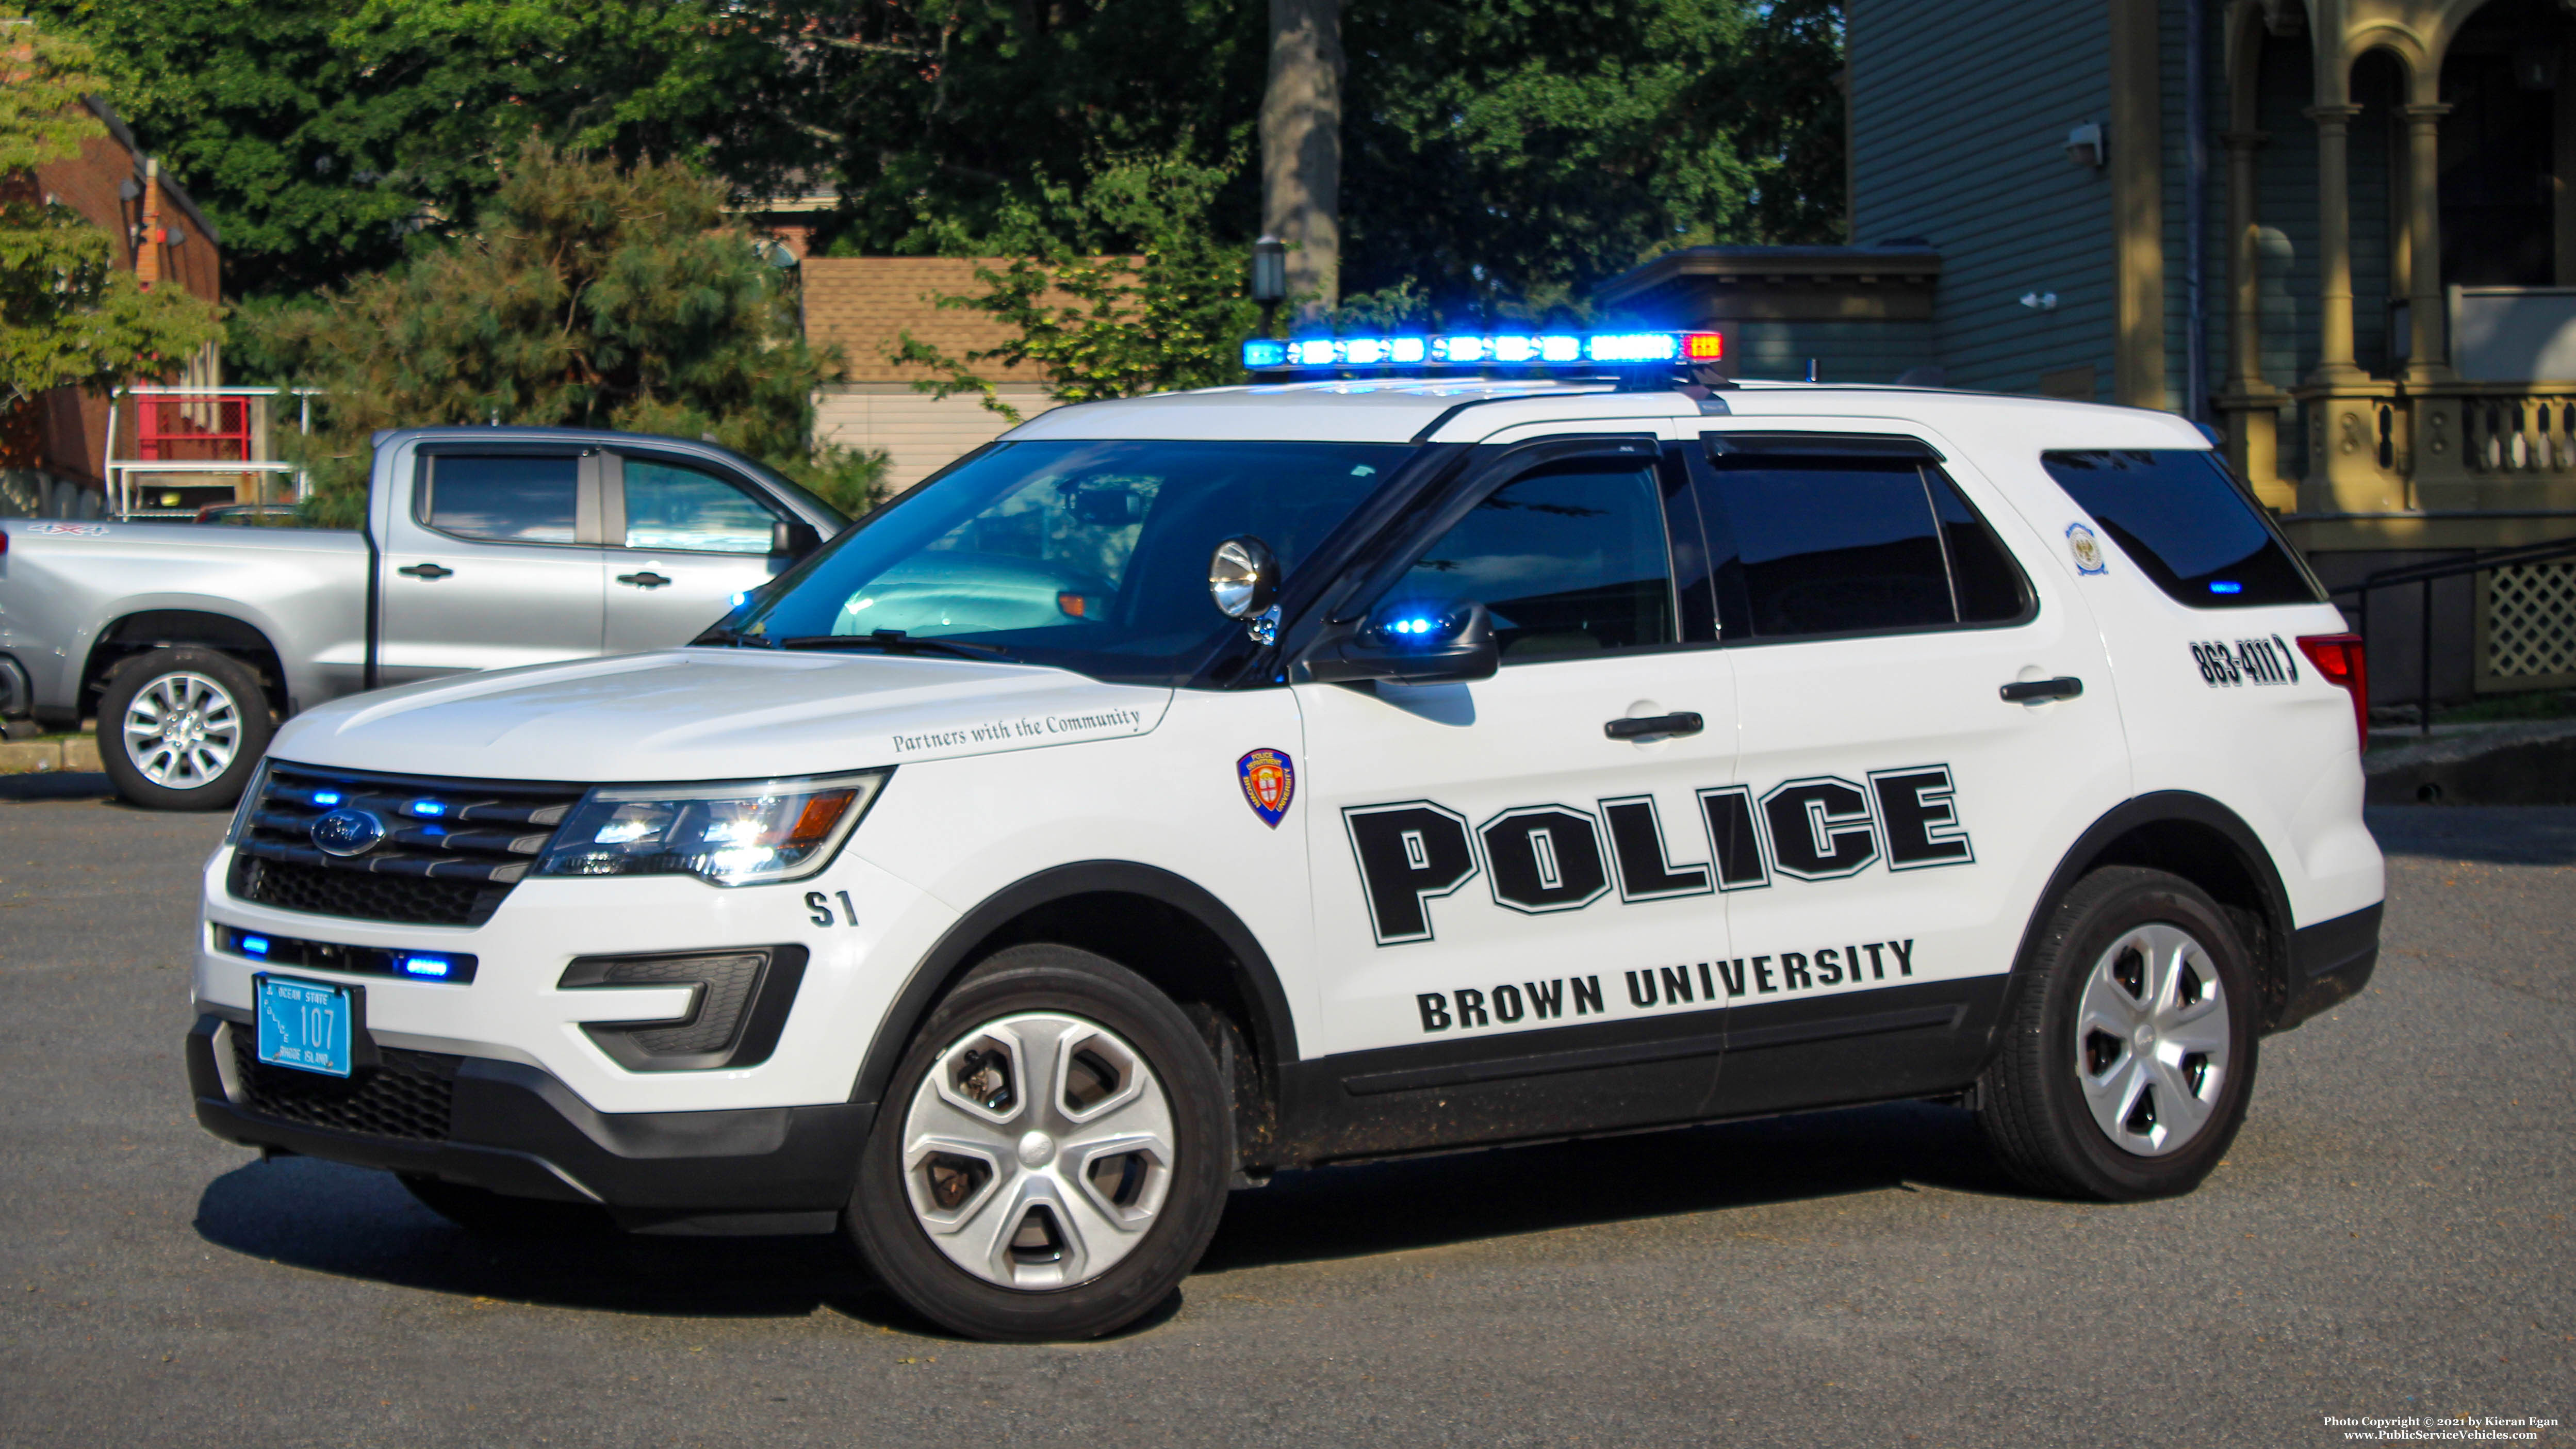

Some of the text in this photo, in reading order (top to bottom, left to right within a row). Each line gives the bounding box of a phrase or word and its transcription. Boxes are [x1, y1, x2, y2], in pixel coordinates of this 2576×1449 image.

[893, 708, 1140, 753] Partners with the Community
[1246, 758, 1282, 771] DEPARTMENT
[1251, 752, 1274, 760] POLICE
[1243, 776, 1261, 808] BROWN
[1275, 768, 1292, 812] UNIVERSITY
[1340, 763, 1976, 948] POLICE
[804, 890, 859, 928] S1
[278, 986, 327, 1005] OCEAN STATE
[1416, 938, 1915, 1034] BROWN UNIVERSITY
[264, 999, 289, 1044] POLICE
[301, 1005, 334, 1050] 107
[280, 1046, 329, 1066] RHODE ISLAND
